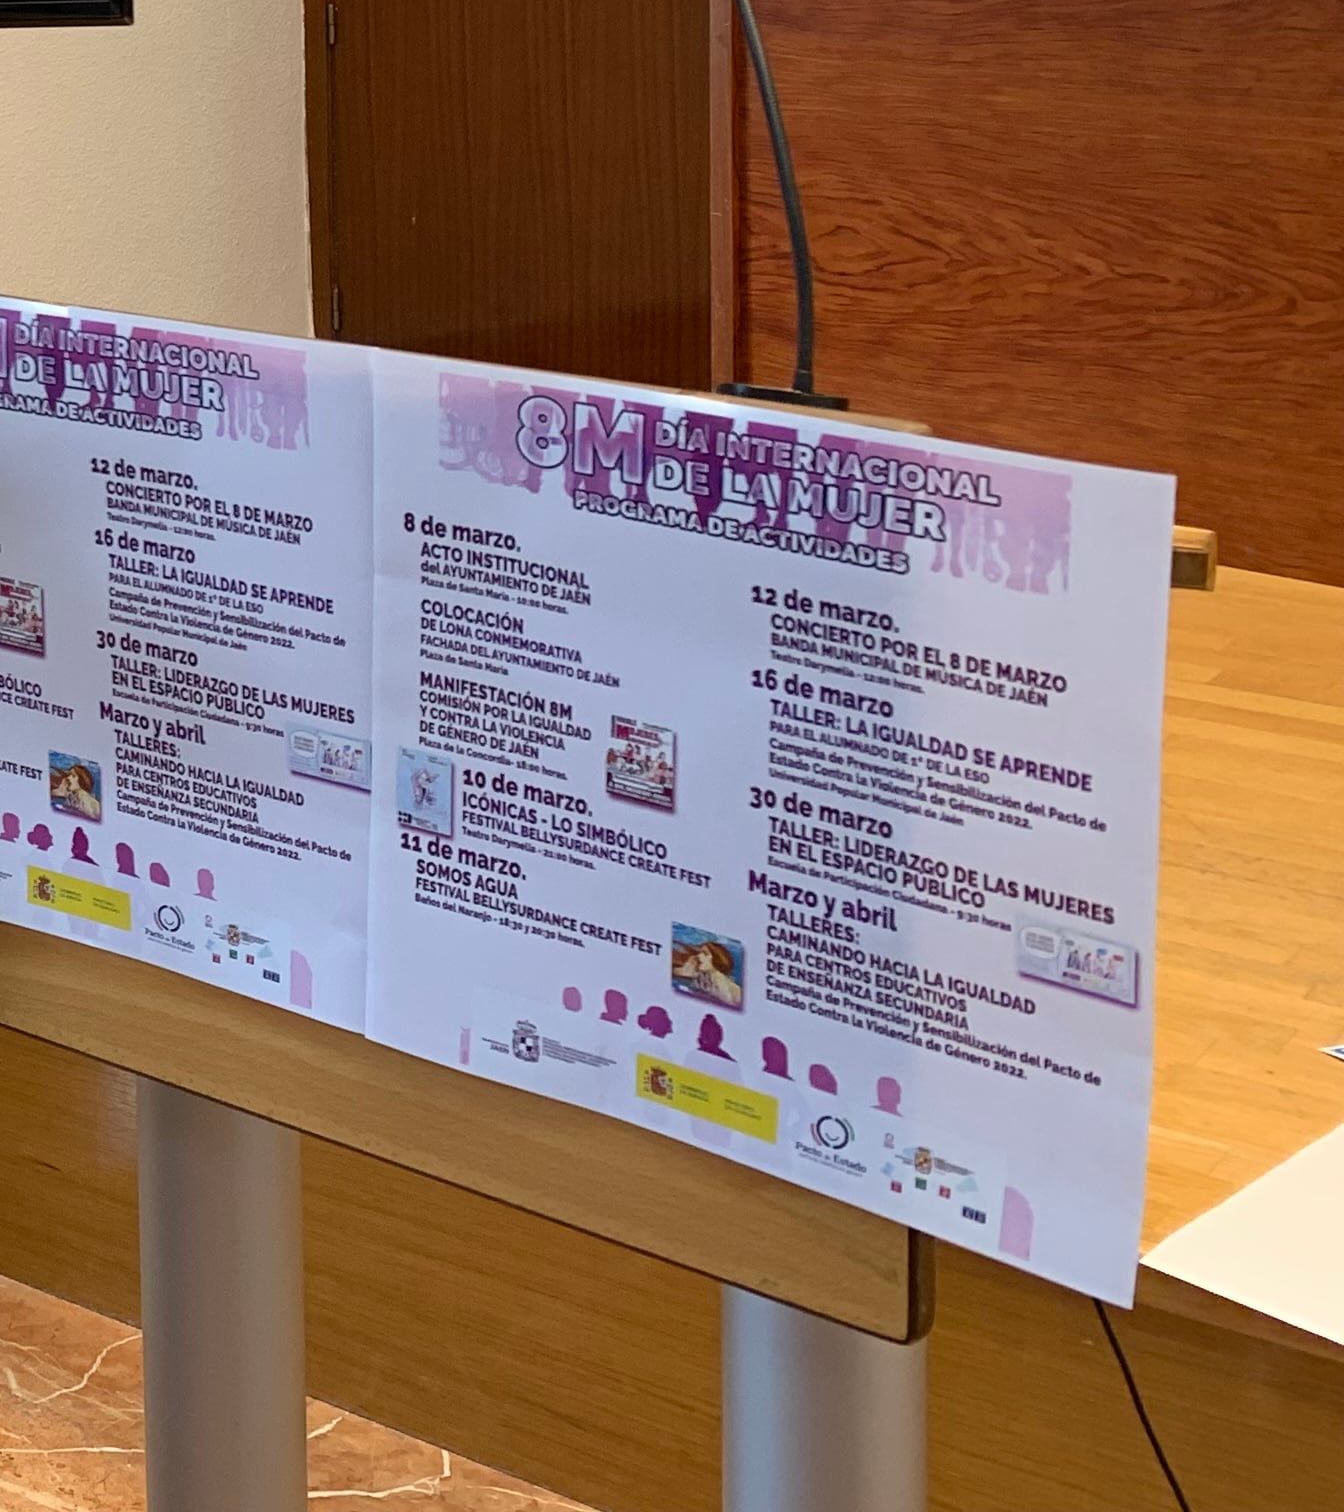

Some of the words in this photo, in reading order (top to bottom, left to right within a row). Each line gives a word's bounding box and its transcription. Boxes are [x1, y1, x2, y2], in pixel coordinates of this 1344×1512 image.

[13, 318, 54, 350] DÍA
[59, 327, 258, 380] INTERNACIONAL
[13, 350, 56, 386] DE
[63, 355, 106, 394] LA
[112, 365, 224, 412] MUJER
[55, 401, 79, 421] DE
[81, 405, 202, 441] ACTIVIDADES
[90, 458, 111, 475] 12
[114, 459, 136, 479] de
[140, 466, 198, 491] marzo.
[514, 392, 644, 487] 8M
[653, 415, 709, 456] DÍA
[715, 429, 1002, 508] INTERNACIONAL
[651, 453, 711, 499] DE
[719, 463, 781, 512] LA
[787, 477, 946, 542] MUJER
[95, 528, 114, 547] 16
[118, 532, 139, 552] de
[143, 540, 195, 564] marzo
[404, 512, 415, 533] 8
[420, 515, 447, 538] de
[452, 524, 521, 552] marzo.
[572, 488, 702, 533] PROGRAMA
[702, 514, 737, 540] DE
[741, 521, 909, 576] ACTIVIDADES
[420, 541, 463, 563] ACTO
[467, 549, 589, 591] INSTITUCIONAL
[421, 599, 524, 635] COLOCACIÓN
[752, 585, 777, 607] 12
[783, 589, 814, 614] de
[819, 600, 899, 633] marzo.
[96, 630, 116, 649] 30
[120, 633, 142, 654] de
[145, 642, 198, 667] marzo
[421, 616, 437, 631] DE
[439, 620, 473, 639] LONA
[474, 628, 582, 664] CONMEMORATIVA
[770, 613, 876, 650] CONCIERTO
[880, 636, 918, 661] POR
[923, 646, 946, 669] EL
[949, 652, 961, 670] 8
[966, 655, 991, 677] DE
[996, 662, 1067, 693] MARZO
[419, 689, 481, 714] COMISIÓN
[483, 703, 509, 721] POR
[511, 710, 527, 725] LA
[529, 714, 592, 741] IGUALDAD
[420, 671, 545, 714] MANIFESTACIÓN
[549, 701, 572, 721] 8M
[752, 669, 778, 691] 16
[784, 674, 814, 699] de
[820, 686, 894, 718] marzo
[99, 701, 149, 730] Marzo
[152, 718, 162, 736] y
[166, 719, 206, 745] abril
[419, 704, 428, 717] Y
[429, 707, 480, 729] CONTRA
[482, 718, 498, 734] LA
[499, 722, 565, 751] VIOLENCIA
[419, 720, 435, 735] DE
[437, 724, 488, 747] GÉNERO
[490, 736, 506, 752] DE
[508, 741, 539, 759] JAÉN
[770, 698, 841, 730] TALLER:
[846, 716, 869, 738] LA
[872, 723, 968, 761] IGUALDAD
[973, 748, 996, 769] SE
[999, 754, 1092, 792] APRENDE
[463, 769, 486, 789] 10
[491, 773, 519, 797] de
[523, 784, 593, 817] marzo.
[750, 787, 777, 809] 30
[783, 792, 813, 818] de
[819, 805, 893, 839] marzo
[462, 810, 519, 836] FESTIVAL
[520, 825, 625, 865] BELLYSURDANCE
[628, 854, 677, 879] CREATE
[680, 868, 711, 888] FEST
[463, 791, 538, 825] ICÓNICAS
[551, 814, 573, 833] LO
[576, 821, 667, 860] SIMBÓLICO
[401, 832, 422, 853] 11
[427, 837, 453, 860] de
[458, 848, 526, 880] marzo.
[416, 858, 472, 887] SOMOS
[474, 874, 518, 900] AGUA
[768, 816, 839, 849] TALLER:
[844, 836, 949, 879] LIDERAZGO
[954, 865, 978, 888] DE
[983, 873, 1019, 899] LAS
[1024, 884, 1115, 925] MUJERES
[768, 835, 792, 856] EN
[796, 842, 818, 863] EL
[821, 848, 898, 884] ESPACIO
[902, 869, 990, 909] PÚBLICO
[748, 870, 818, 908] Marzo
[823, 894, 836, 917] y
[841, 898, 898, 932] abril
[767, 903, 860, 945] TALLERES:
[767, 925, 866, 965] CAMINANDO
[870, 953, 920, 982] HACIA
[923, 969, 944, 989] LA
[948, 976, 1036, 1015] IGUALDAD
